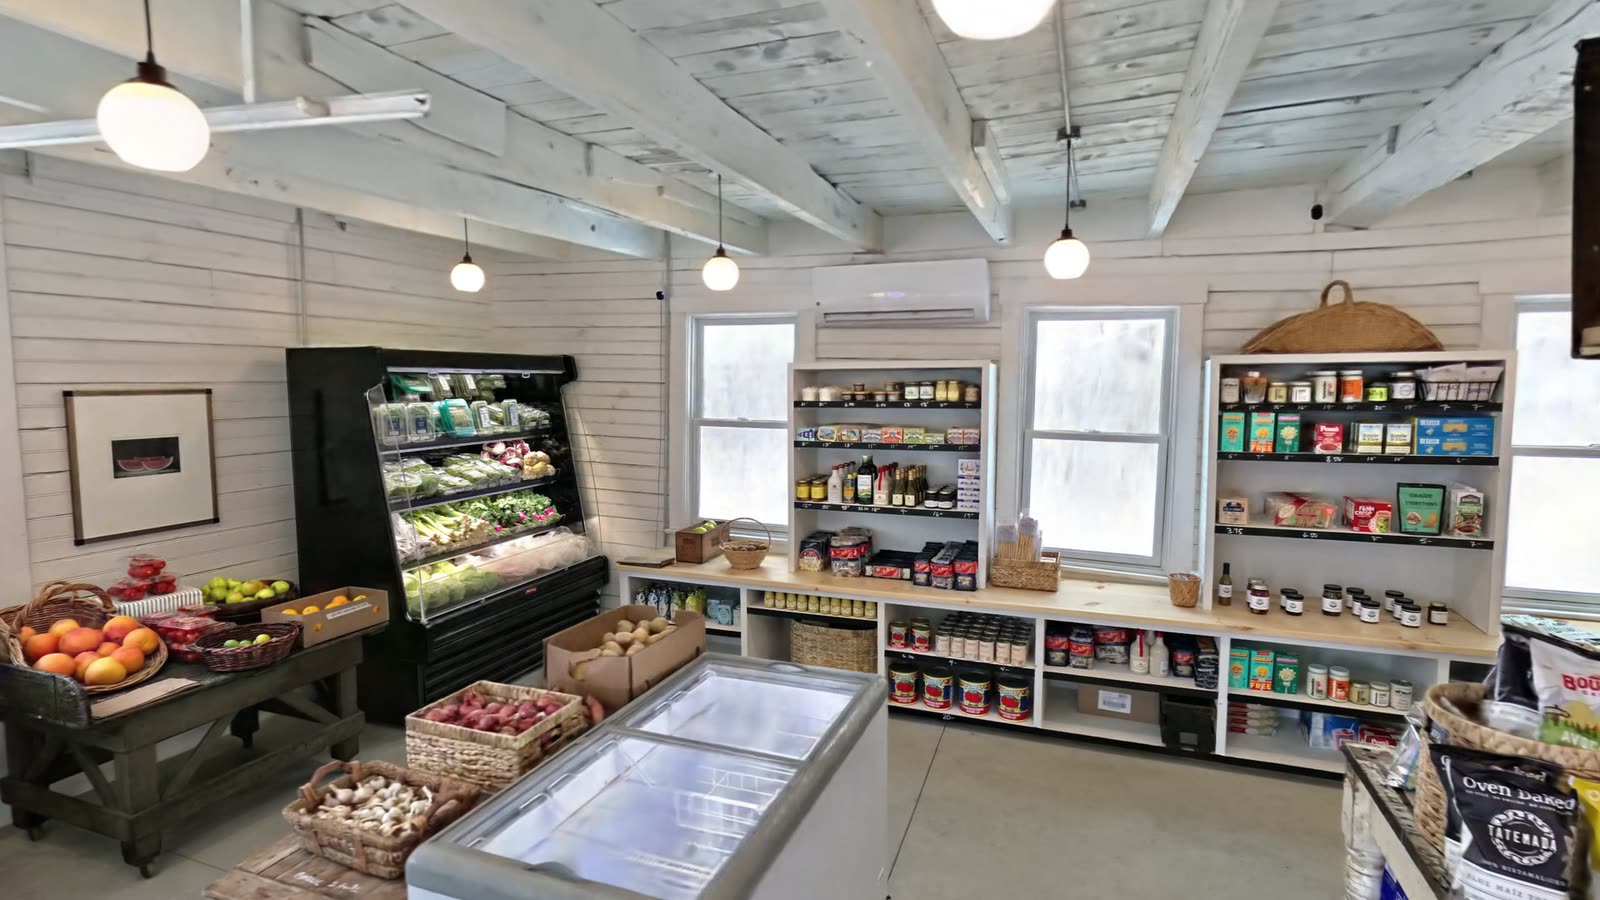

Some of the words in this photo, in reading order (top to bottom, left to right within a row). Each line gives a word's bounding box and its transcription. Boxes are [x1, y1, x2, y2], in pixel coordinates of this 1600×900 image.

[1250, 444, 1272, 452] FREE
[1226, 527, 1244, 535] 3.75
[1250, 682, 1272, 690] FREE
[1462, 776, 1512, 798] Oven
[1517, 789, 1576, 810] Baked
